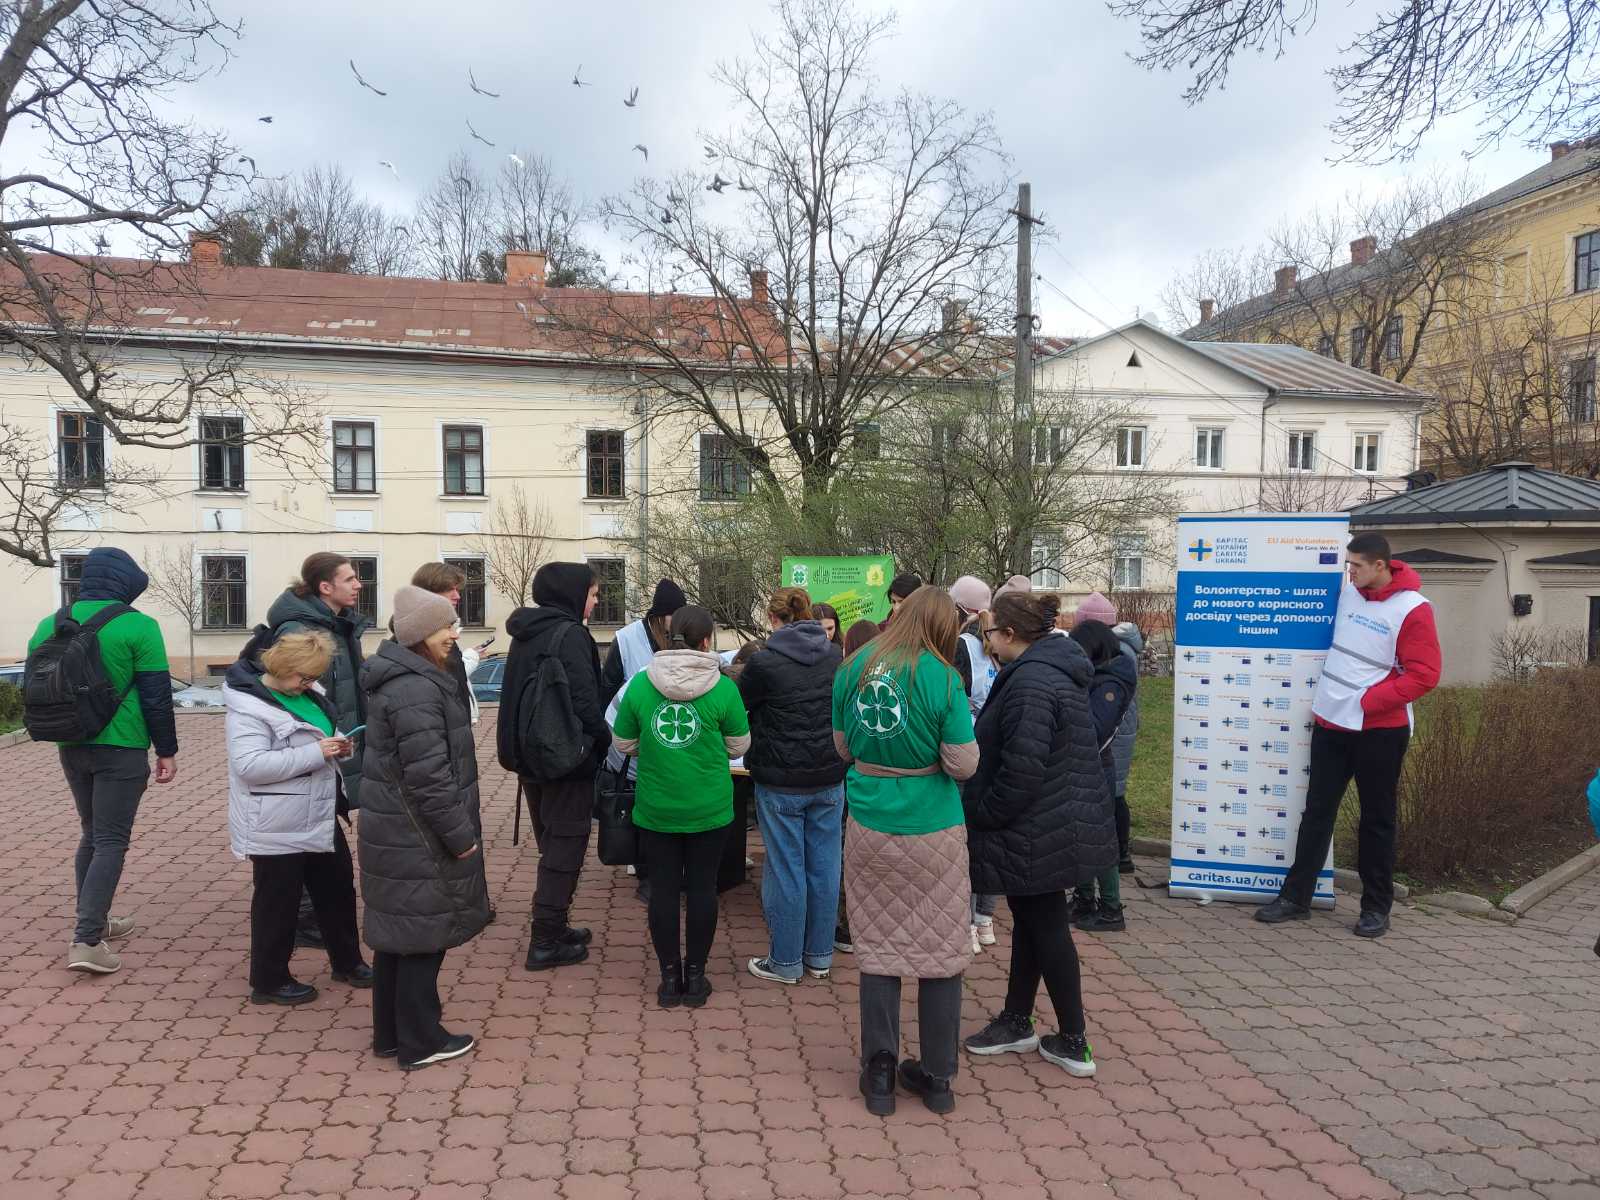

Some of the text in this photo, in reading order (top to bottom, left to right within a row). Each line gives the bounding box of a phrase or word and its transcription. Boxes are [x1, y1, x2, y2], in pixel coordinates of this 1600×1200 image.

[1194, 585, 1281, 597] Волонтерство
[1293, 587, 1328, 596] шлях
[1193, 599, 1324, 610] до нового корисного
[1185, 611, 1334, 625] досвіду через допомогу
[1239, 624, 1279, 635] іншим
